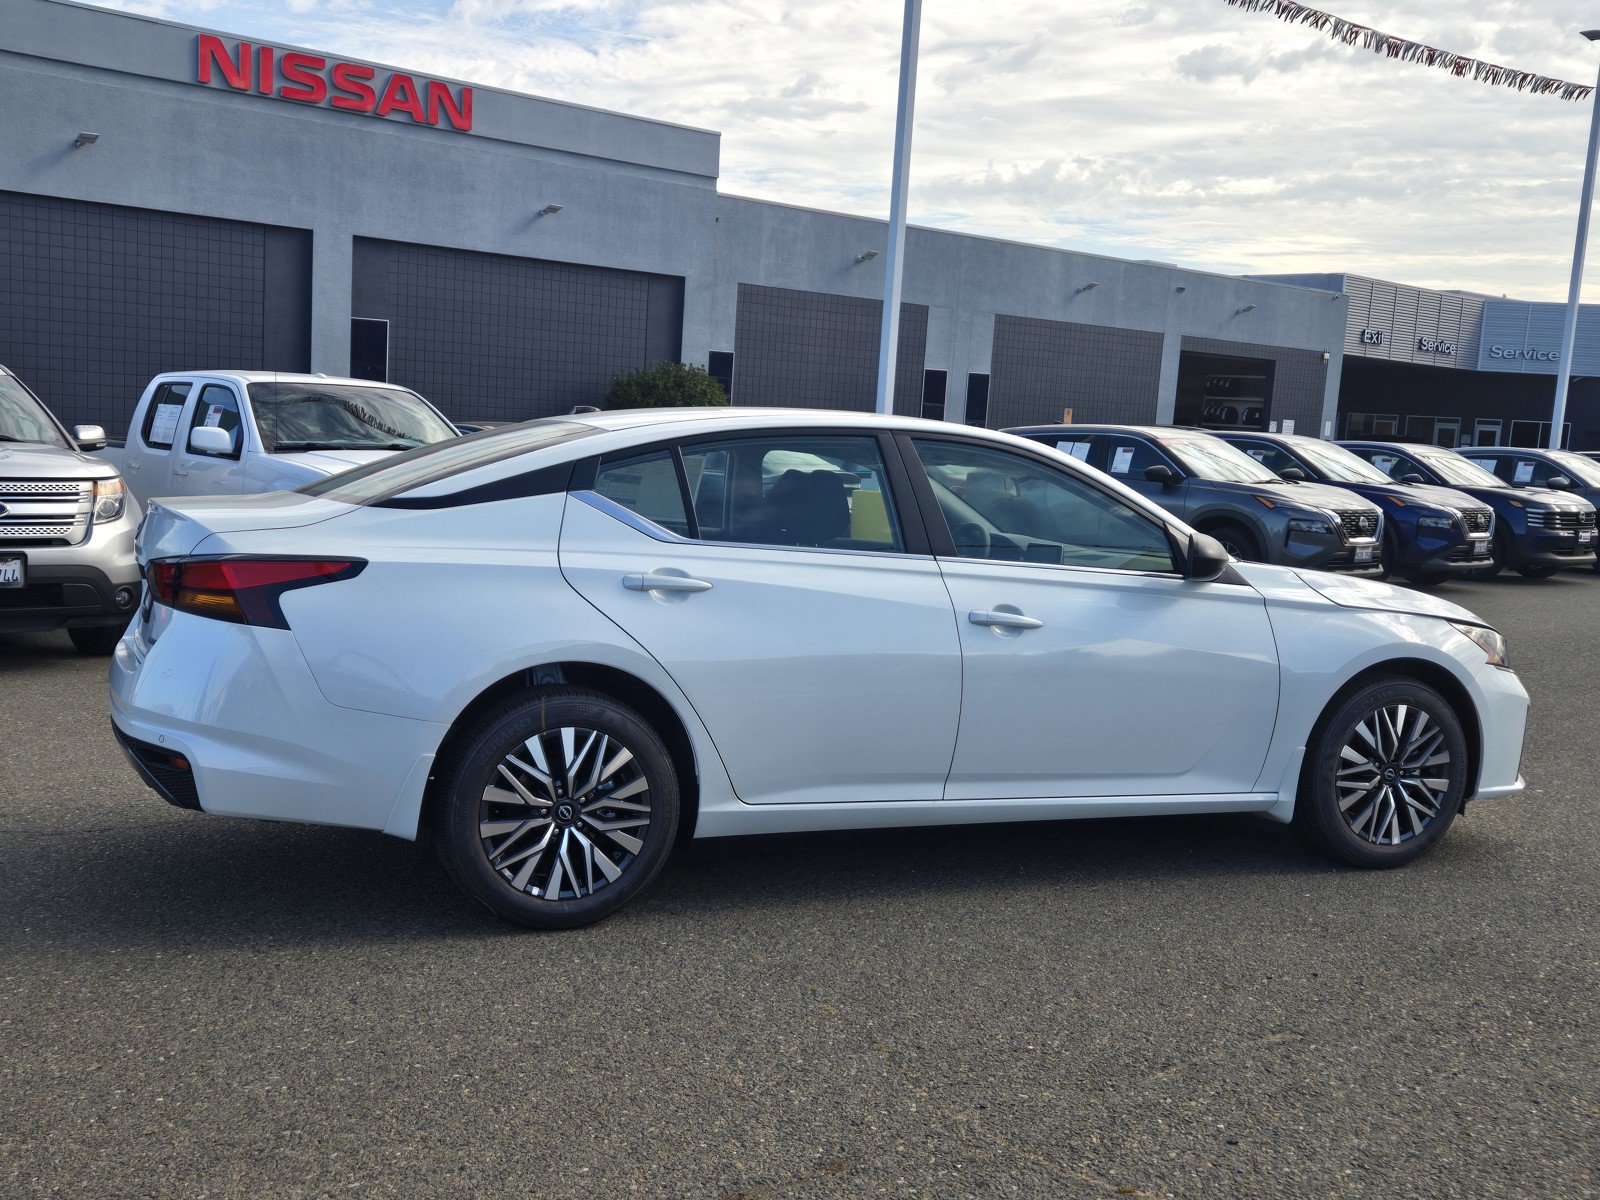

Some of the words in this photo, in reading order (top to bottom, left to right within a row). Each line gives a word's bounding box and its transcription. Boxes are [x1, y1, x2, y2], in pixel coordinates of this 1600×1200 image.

[198, 34, 473, 132] NISSAN
[1420, 336, 1457, 354] Service
[1490, 345, 1560, 361] Service
[0, 568, 19, 582] 44
